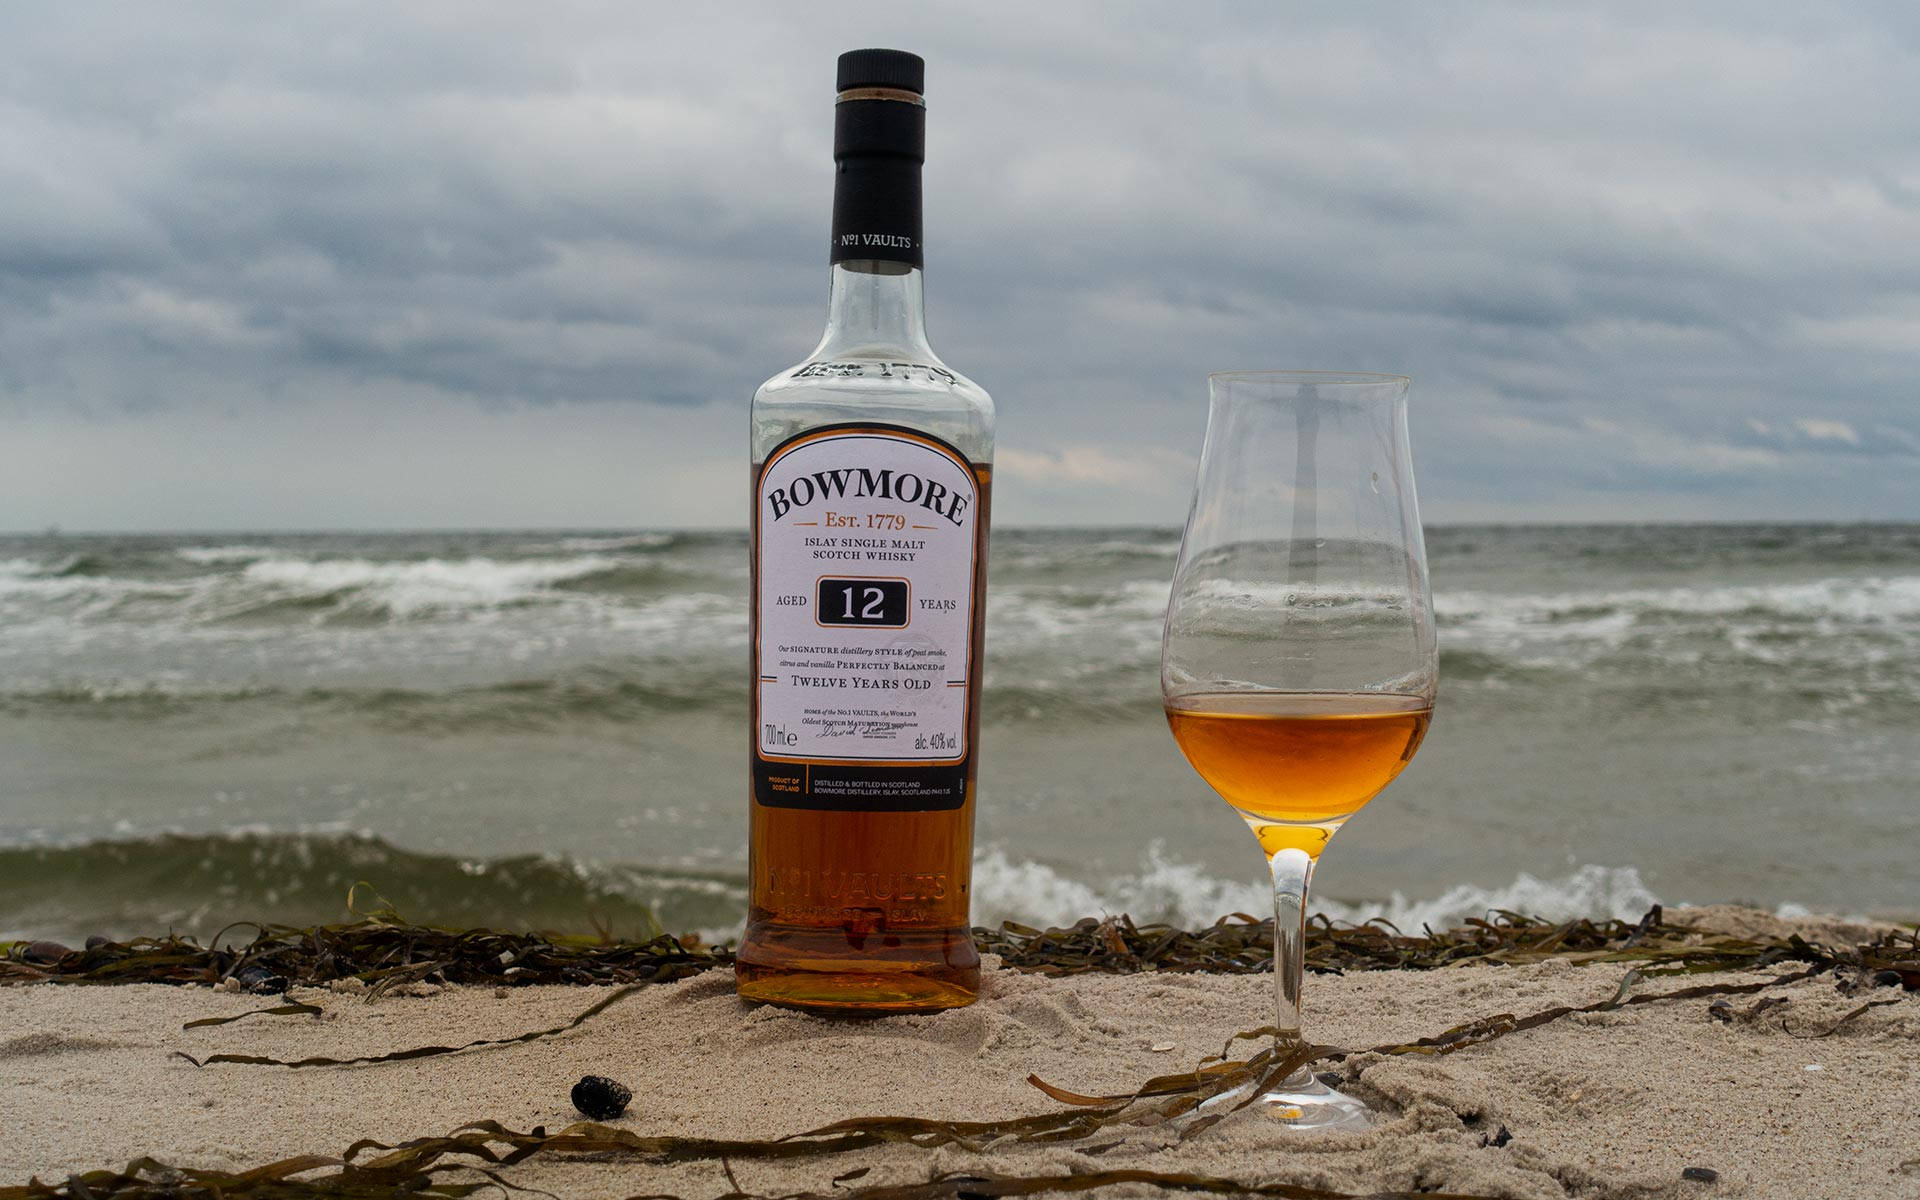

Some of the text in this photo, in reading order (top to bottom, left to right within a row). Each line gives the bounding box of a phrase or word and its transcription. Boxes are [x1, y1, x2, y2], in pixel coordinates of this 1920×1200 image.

[862, 233, 911, 249] VAULTS
[767, 468, 969, 527] BOWMORE
[866, 513, 906, 531] 1779
[804, 537, 926, 550] ISLAY SINGLE MALT
[812, 550, 916, 562] SCOTCH WHISKY
[776, 595, 807, 606] AGED
[841, 587, 886, 619] 12
[920, 599, 956, 610] YEARS
[790, 645, 839, 654] SIGNATURE
[840, 646, 873, 657] distillery
[874, 648, 903, 656] STYLE
[796, 660, 810, 668] and
[810, 660, 835, 669] vanilla
[828, 708, 837, 716] the
[801, 718, 821, 726] Oldest
[914, 733, 929, 750] alc.
[929, 732, 946, 750] 40%
[772, 784, 800, 792] SCOTLAND
[814, 779, 844, 787] DISTILLED
[844, 780, 851, 788] &
[851, 780, 880, 788] BOTTLED
[888, 781, 921, 789] SCOTLAND
[814, 787, 846, 795] BOWMORE
[900, 788, 931, 796] SCOTLAND
